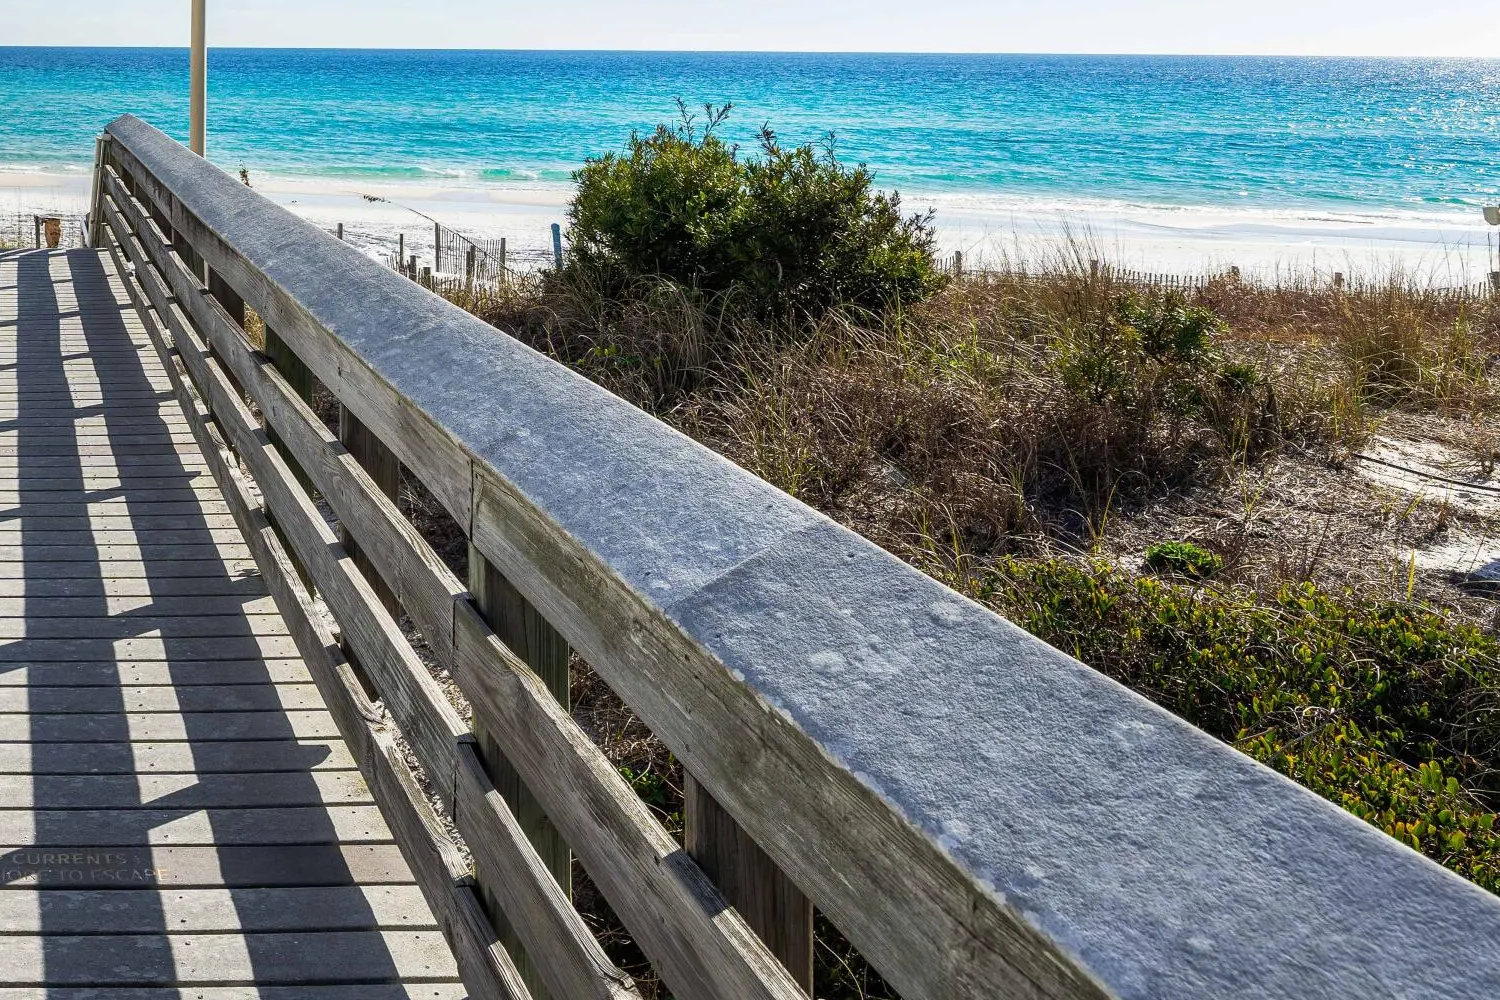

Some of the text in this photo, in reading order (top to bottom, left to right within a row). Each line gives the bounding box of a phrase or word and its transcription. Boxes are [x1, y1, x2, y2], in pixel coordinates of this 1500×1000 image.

[13, 853, 127, 864] CURRENTS
[59, 868, 84, 881] TO
[91, 868, 171, 881] ESCAPE
